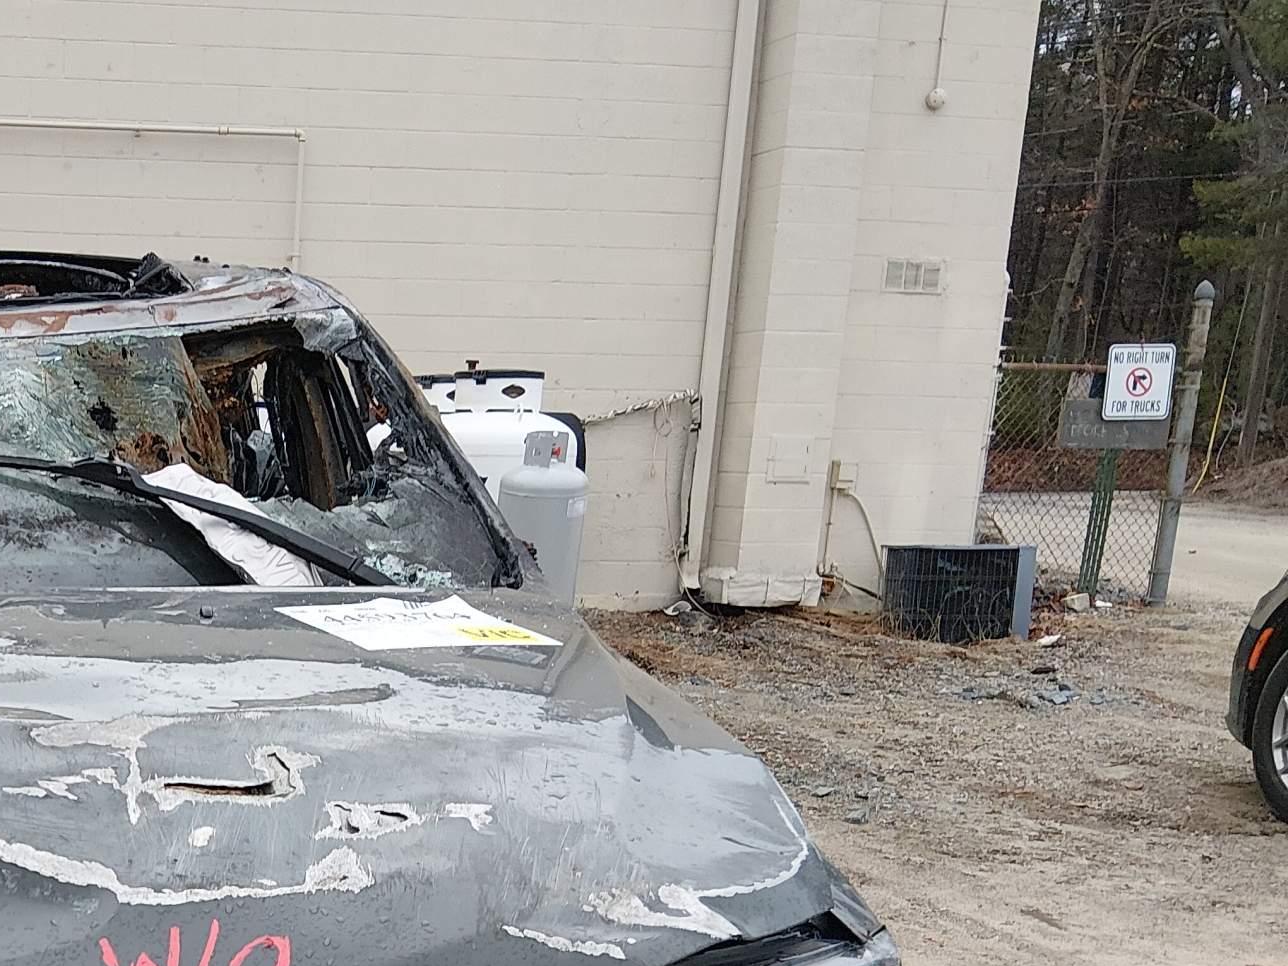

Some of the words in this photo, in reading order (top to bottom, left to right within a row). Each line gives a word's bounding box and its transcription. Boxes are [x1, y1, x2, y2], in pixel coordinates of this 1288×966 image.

[1113, 352, 1124, 363] NO
[1127, 352, 1148, 363] RIGHT
[1151, 352, 1170, 363] TURN
[1111, 400, 1127, 413] FOR
[1130, 400, 1161, 413] TRUCKS
